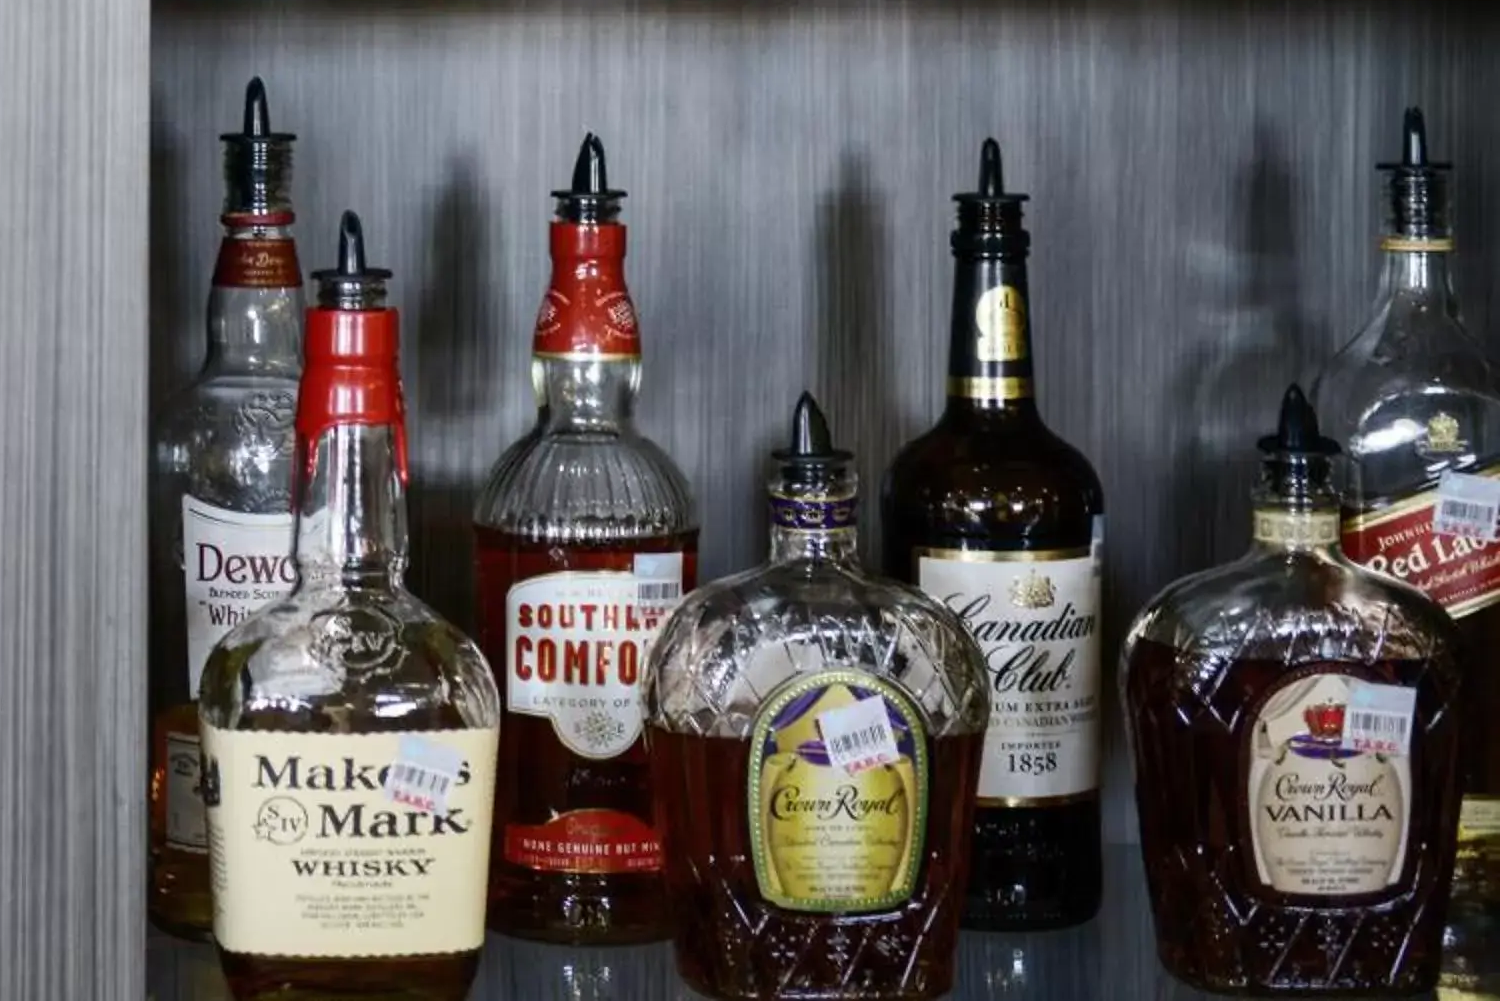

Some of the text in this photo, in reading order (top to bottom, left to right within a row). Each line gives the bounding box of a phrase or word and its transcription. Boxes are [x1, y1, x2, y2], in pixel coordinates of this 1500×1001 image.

[1366, 533, 1488, 578] Red Lab
[209, 602, 252, 626] Whi
[940, 592, 1096, 644] Canadian
[515, 634, 638, 687] COMFO
[1025, 701, 1069, 712] EXTRA
[1008, 751, 1058, 777] 1858
[1275, 773, 1385, 802] Crown Royal
[770, 784, 905, 822] Crown Royal
[1265, 804, 1394, 822] VANILLA
[316, 803, 470, 839] Mark
[557, 842, 610, 855] GENUINE
[615, 842, 637, 854] BUT
[641, 841, 661, 852] MIN
[292, 857, 436, 877] WHISKY
